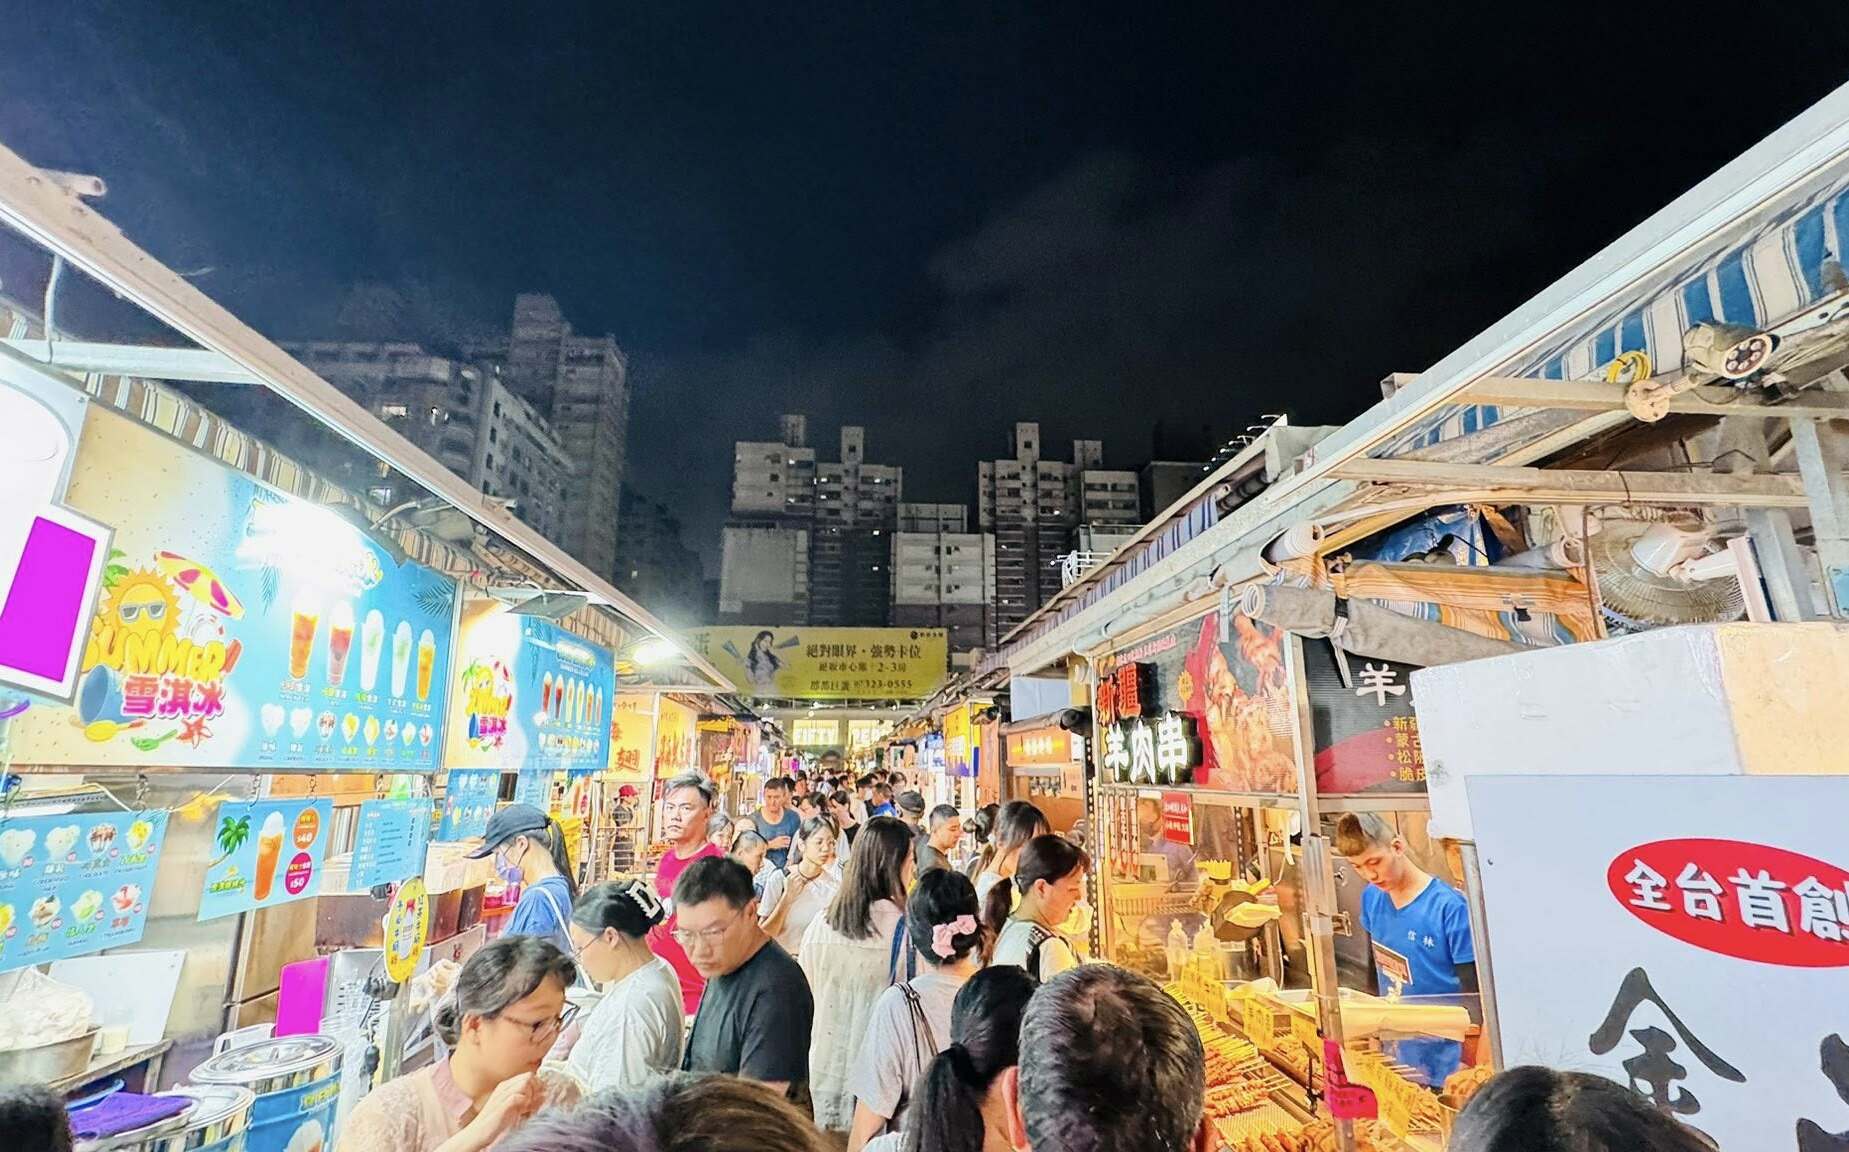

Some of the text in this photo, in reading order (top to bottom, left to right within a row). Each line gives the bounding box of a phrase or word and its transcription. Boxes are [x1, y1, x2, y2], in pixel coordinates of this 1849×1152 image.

[122, 674, 224, 717] 雪淇冰
[1104, 711, 1188, 785] 羊肉串
[1624, 858, 1849, 943] 全台首創
